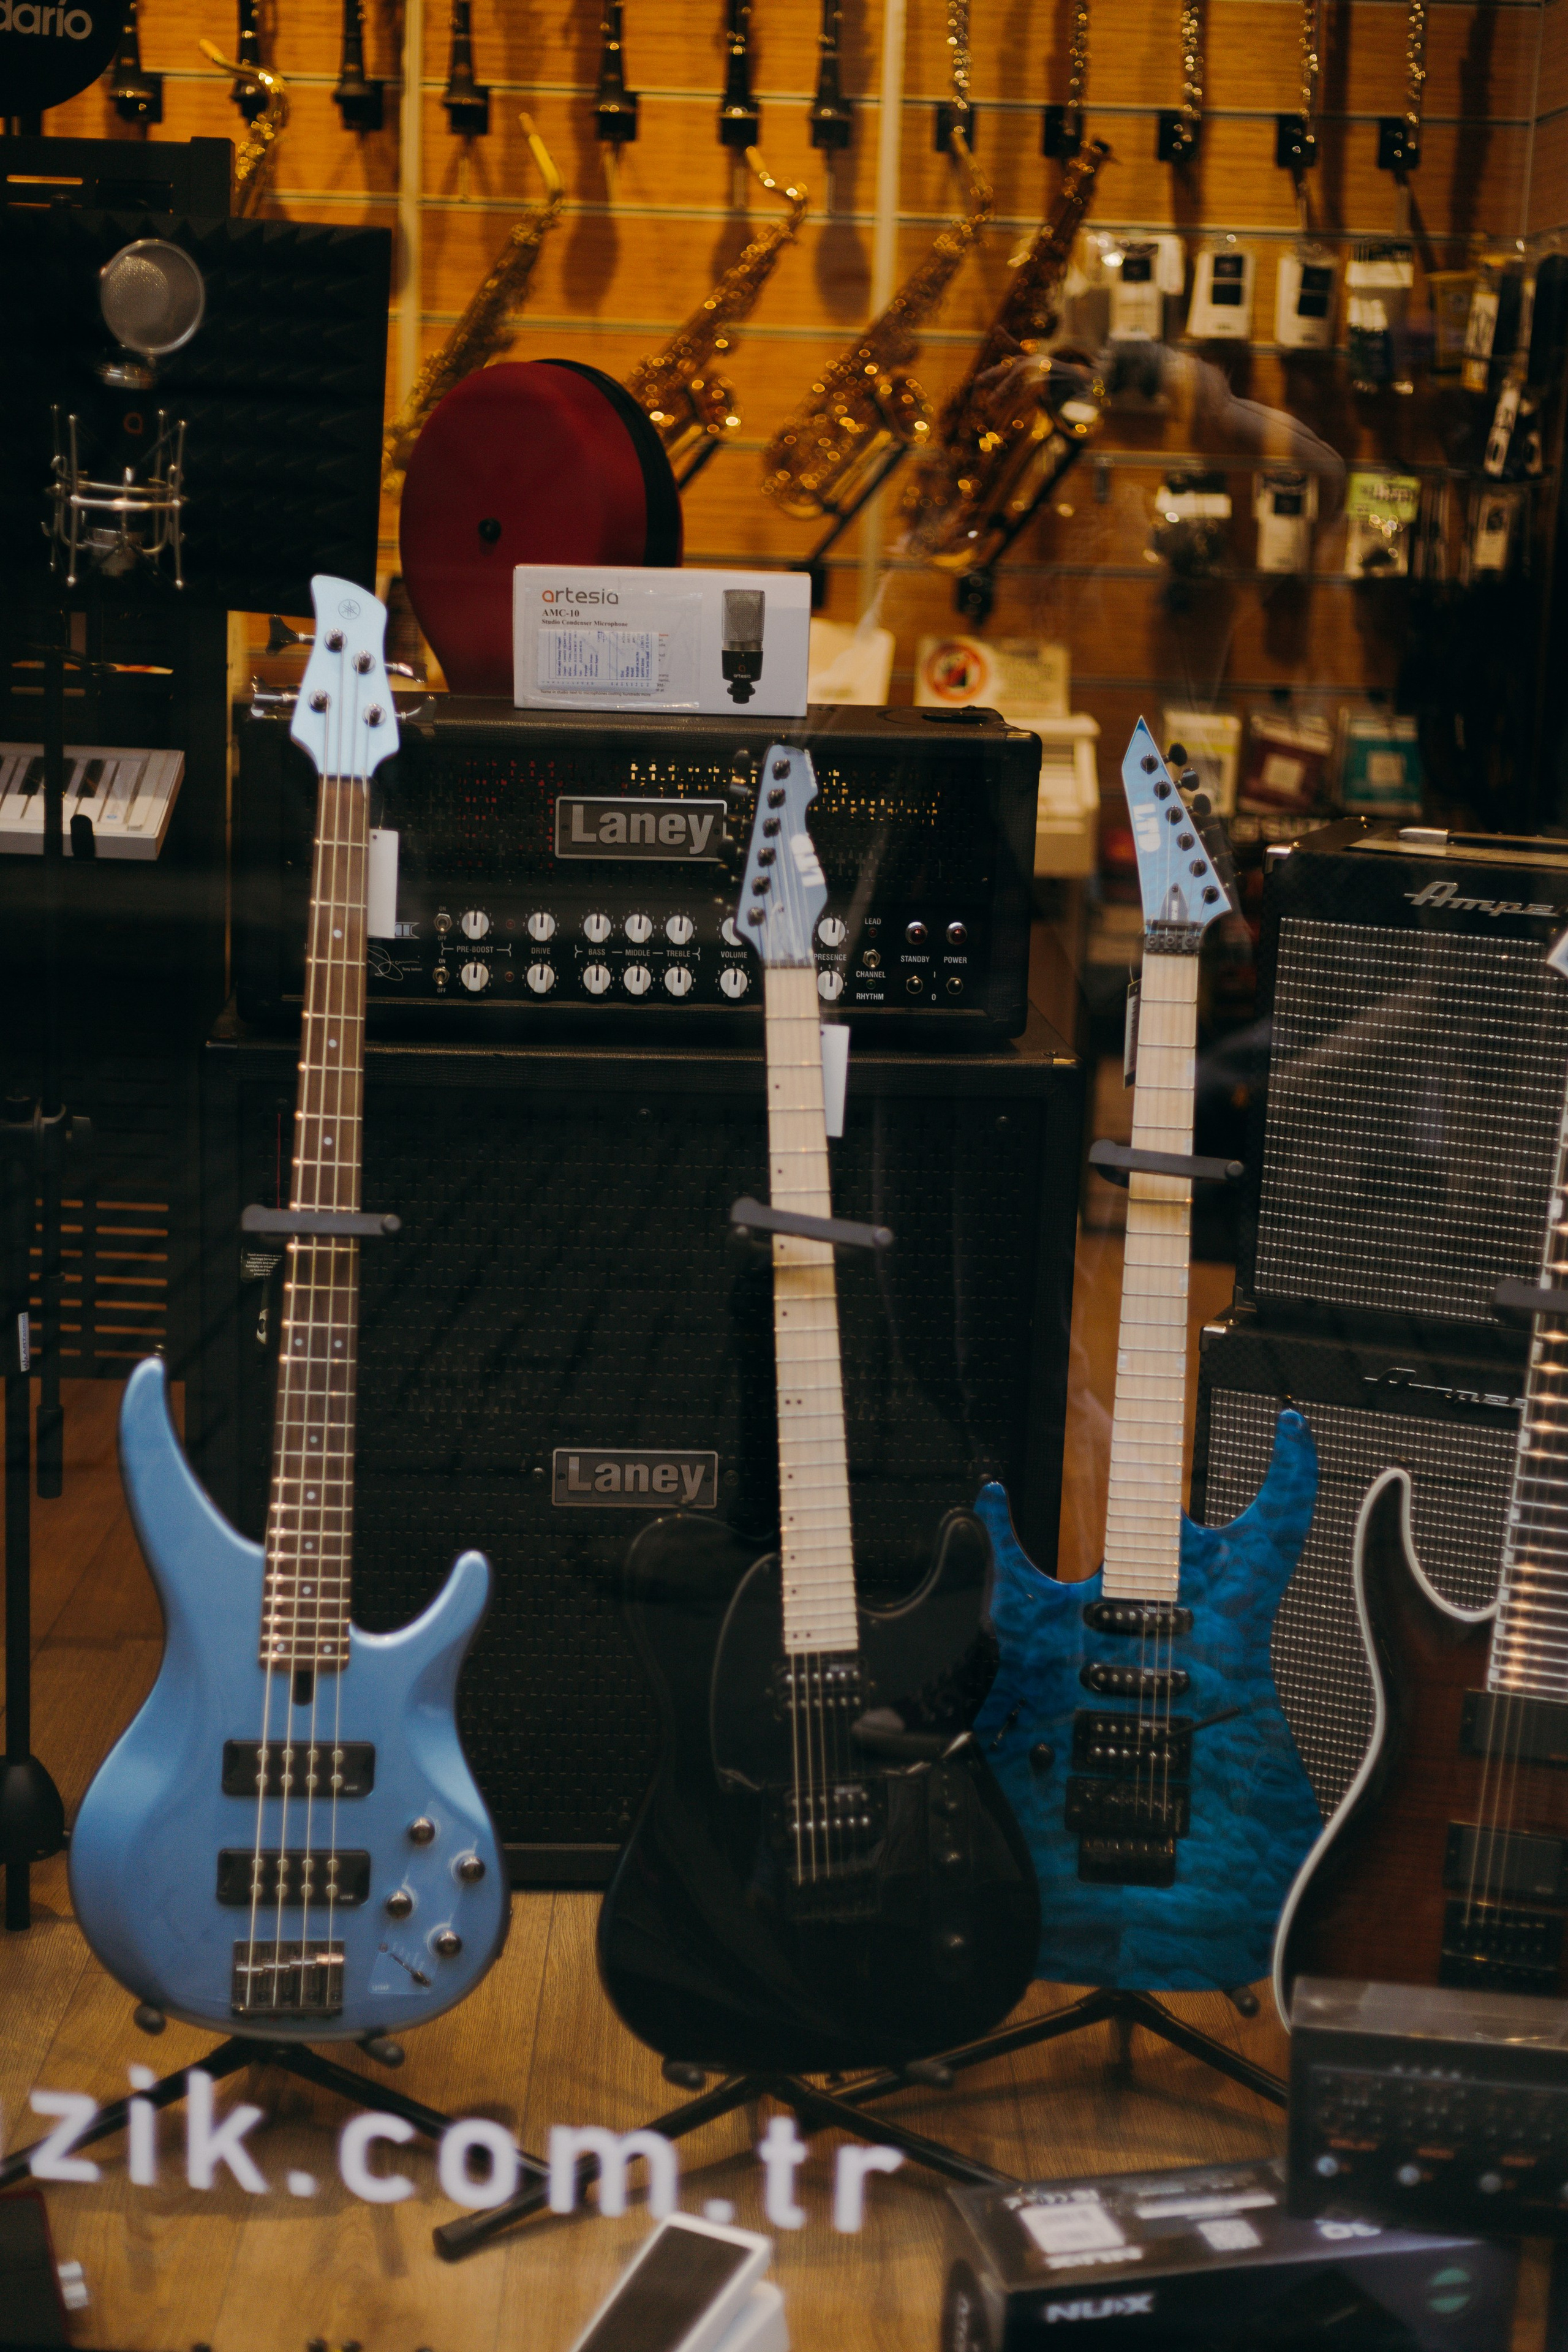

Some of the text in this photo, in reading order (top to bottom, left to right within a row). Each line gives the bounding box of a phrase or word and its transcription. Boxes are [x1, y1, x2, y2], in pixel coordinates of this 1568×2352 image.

[541, 587, 619, 605] artesia
[571, 804, 714, 855] Laney
[1133, 803, 1161, 852] LTD
[1402, 881, 1566, 918] Ampe
[567, 1456, 706, 1499] Laney
[28, 2063, 907, 2234] zik.com.tr
[1043, 2291, 1155, 2324] NUX
